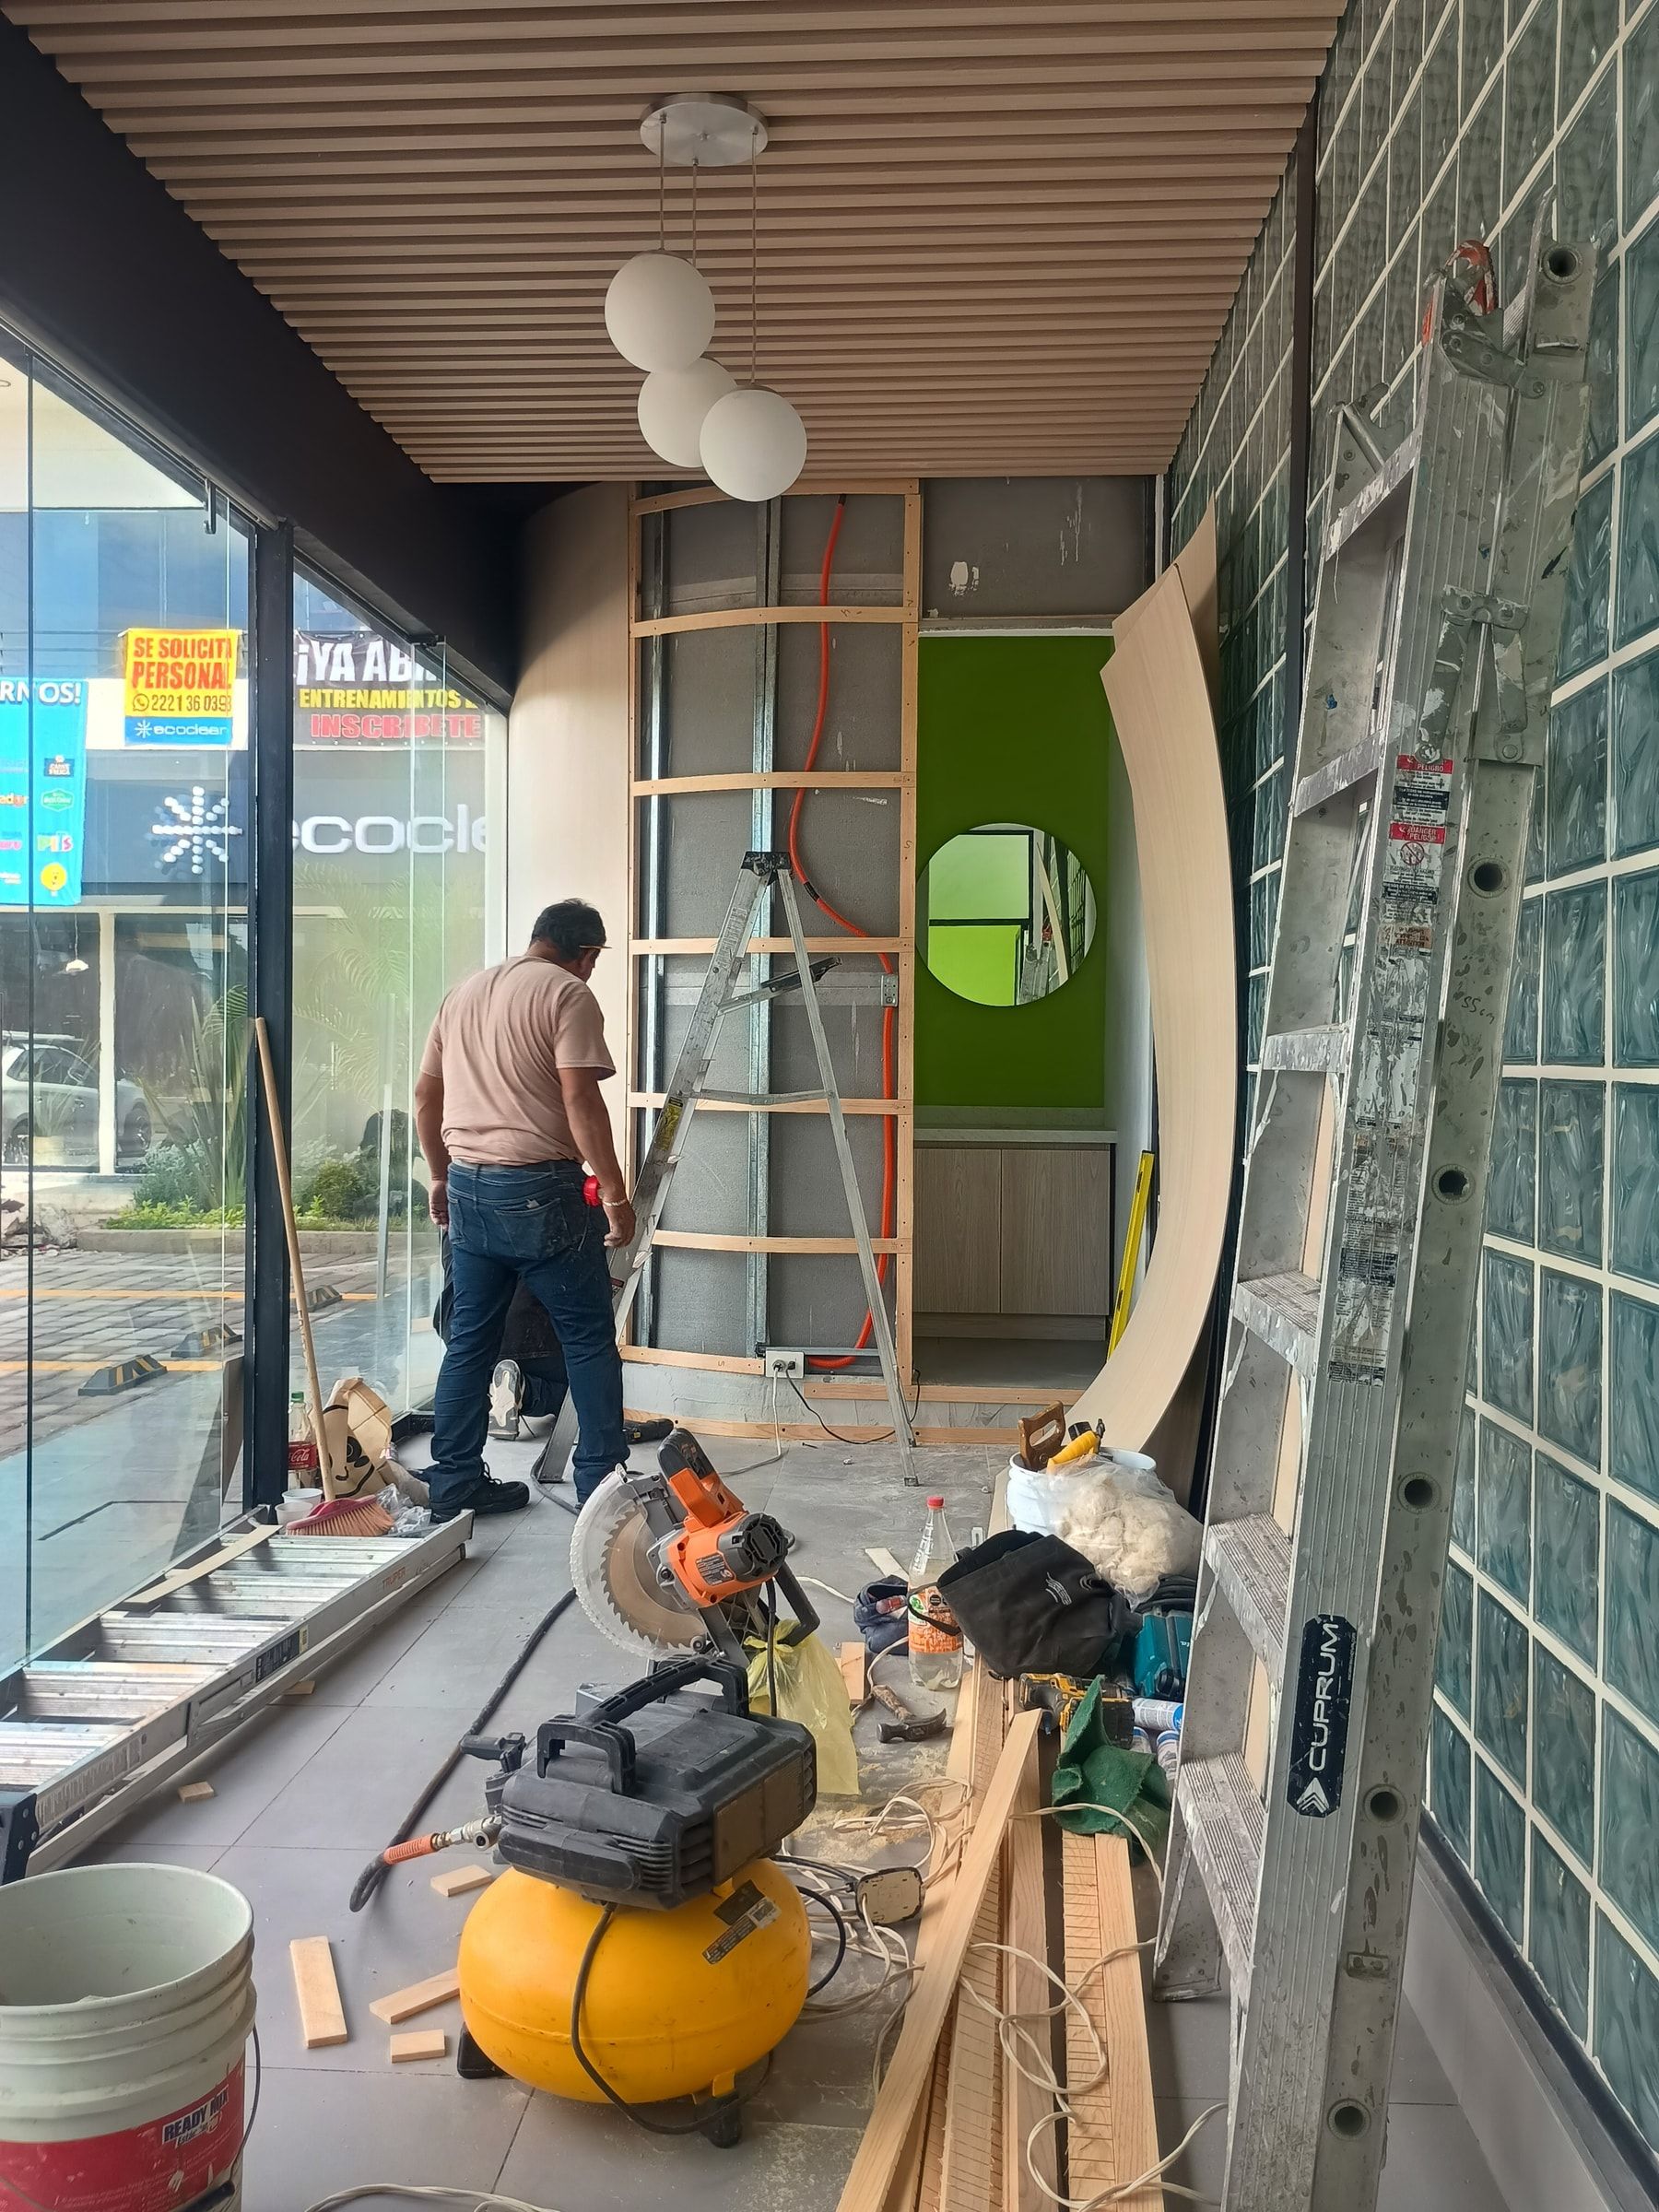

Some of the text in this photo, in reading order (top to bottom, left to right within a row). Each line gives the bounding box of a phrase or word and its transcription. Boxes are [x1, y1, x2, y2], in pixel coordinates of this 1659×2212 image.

[133, 637, 154, 658] SE
[296, 641, 356, 686] ¡YA
[151, 694, 182, 712] 2221
[186, 695, 201, 712] 36
[299, 688, 461, 709] ENTRENAMIENTOS
[153, 724, 228, 735] ecoclear
[310, 714, 481, 738] INSCRIBETE
[293, 804, 486, 853] cocl
[1309, 1623, 1339, 1771] CUPRUM
[164, 2103, 208, 2143] READY
